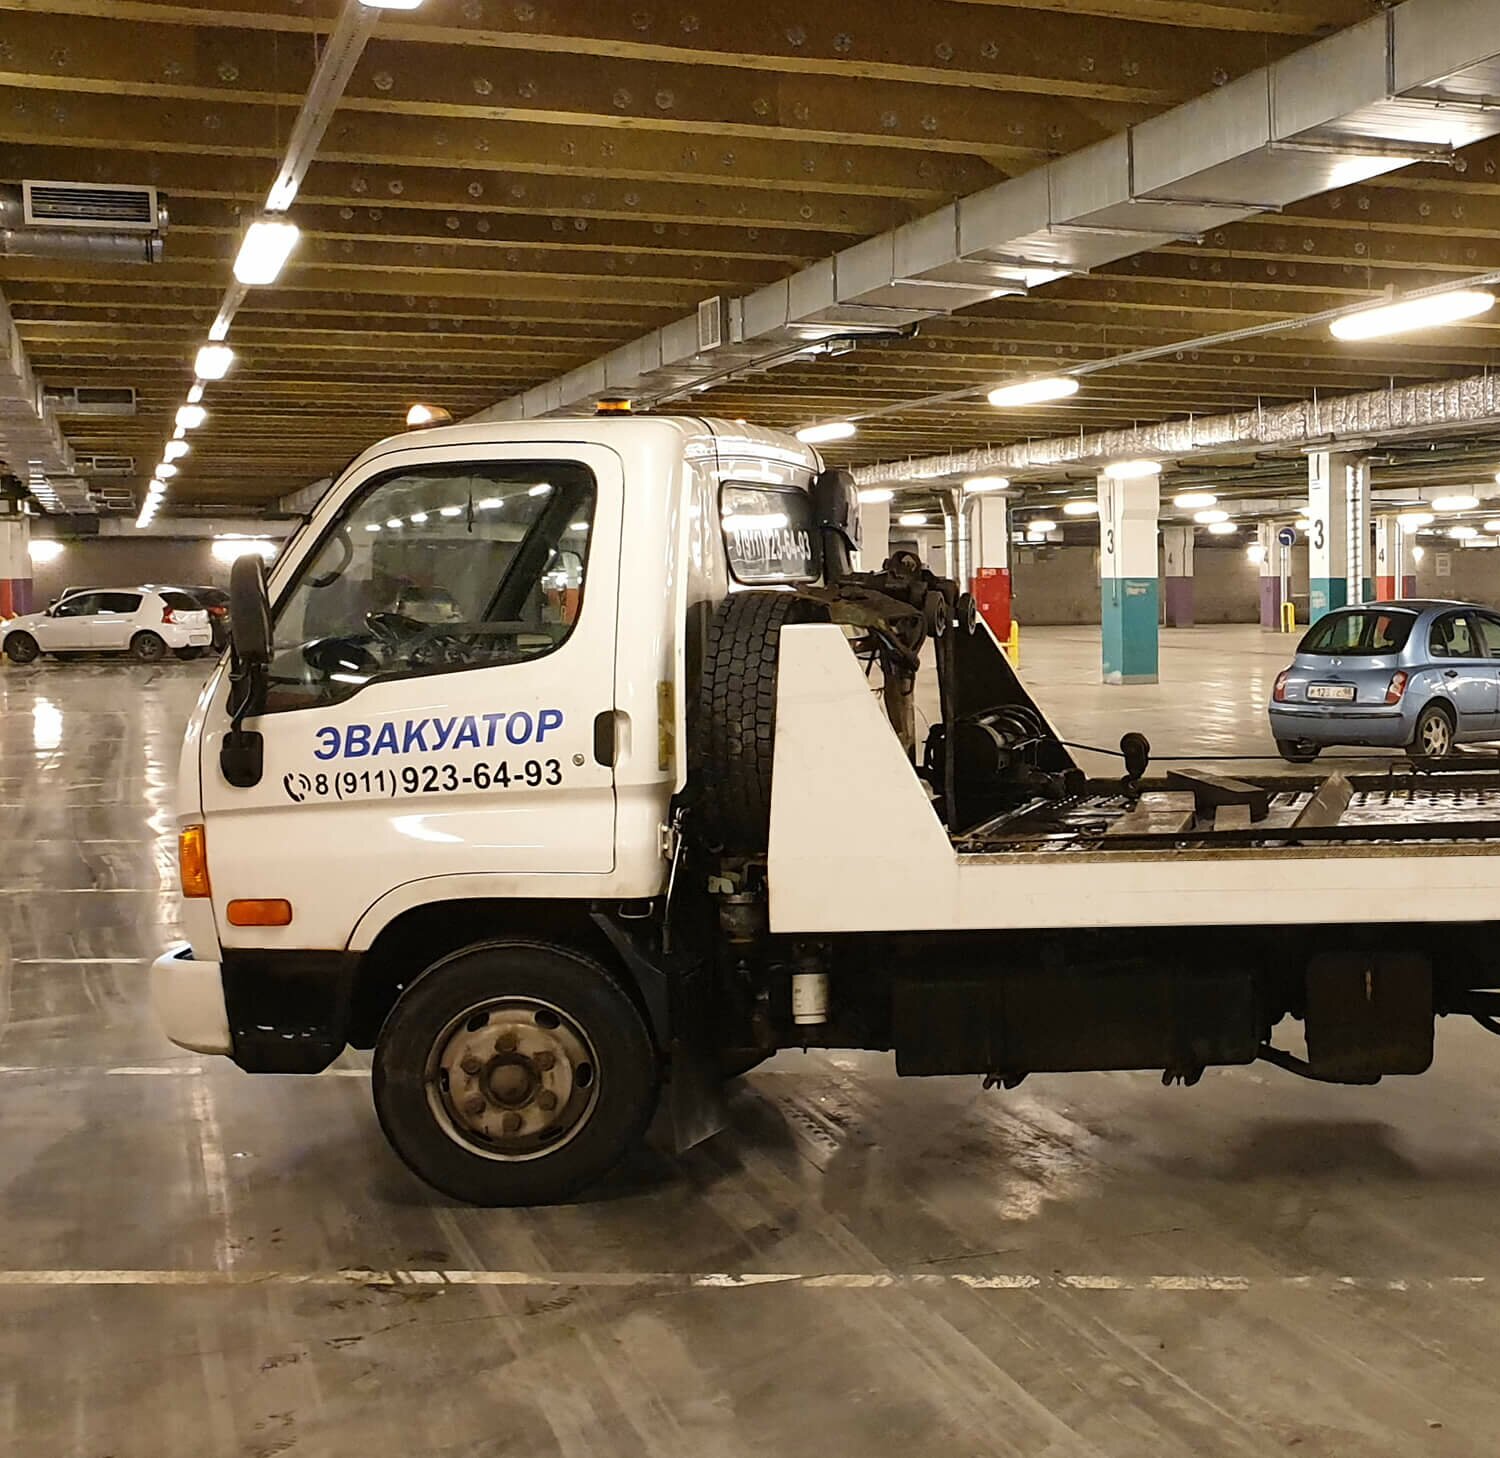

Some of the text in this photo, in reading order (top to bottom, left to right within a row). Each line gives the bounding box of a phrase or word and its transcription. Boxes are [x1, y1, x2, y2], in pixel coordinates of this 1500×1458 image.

[1107, 529, 1114, 554] 3
[1317, 519, 1325, 550] 3
[1378, 548, 1385, 563] 4
[314, 709, 563, 760] ЭВАКУАТОР
[315, 773, 328, 795] 8
[402, 759, 562, 794] 923-64-93
